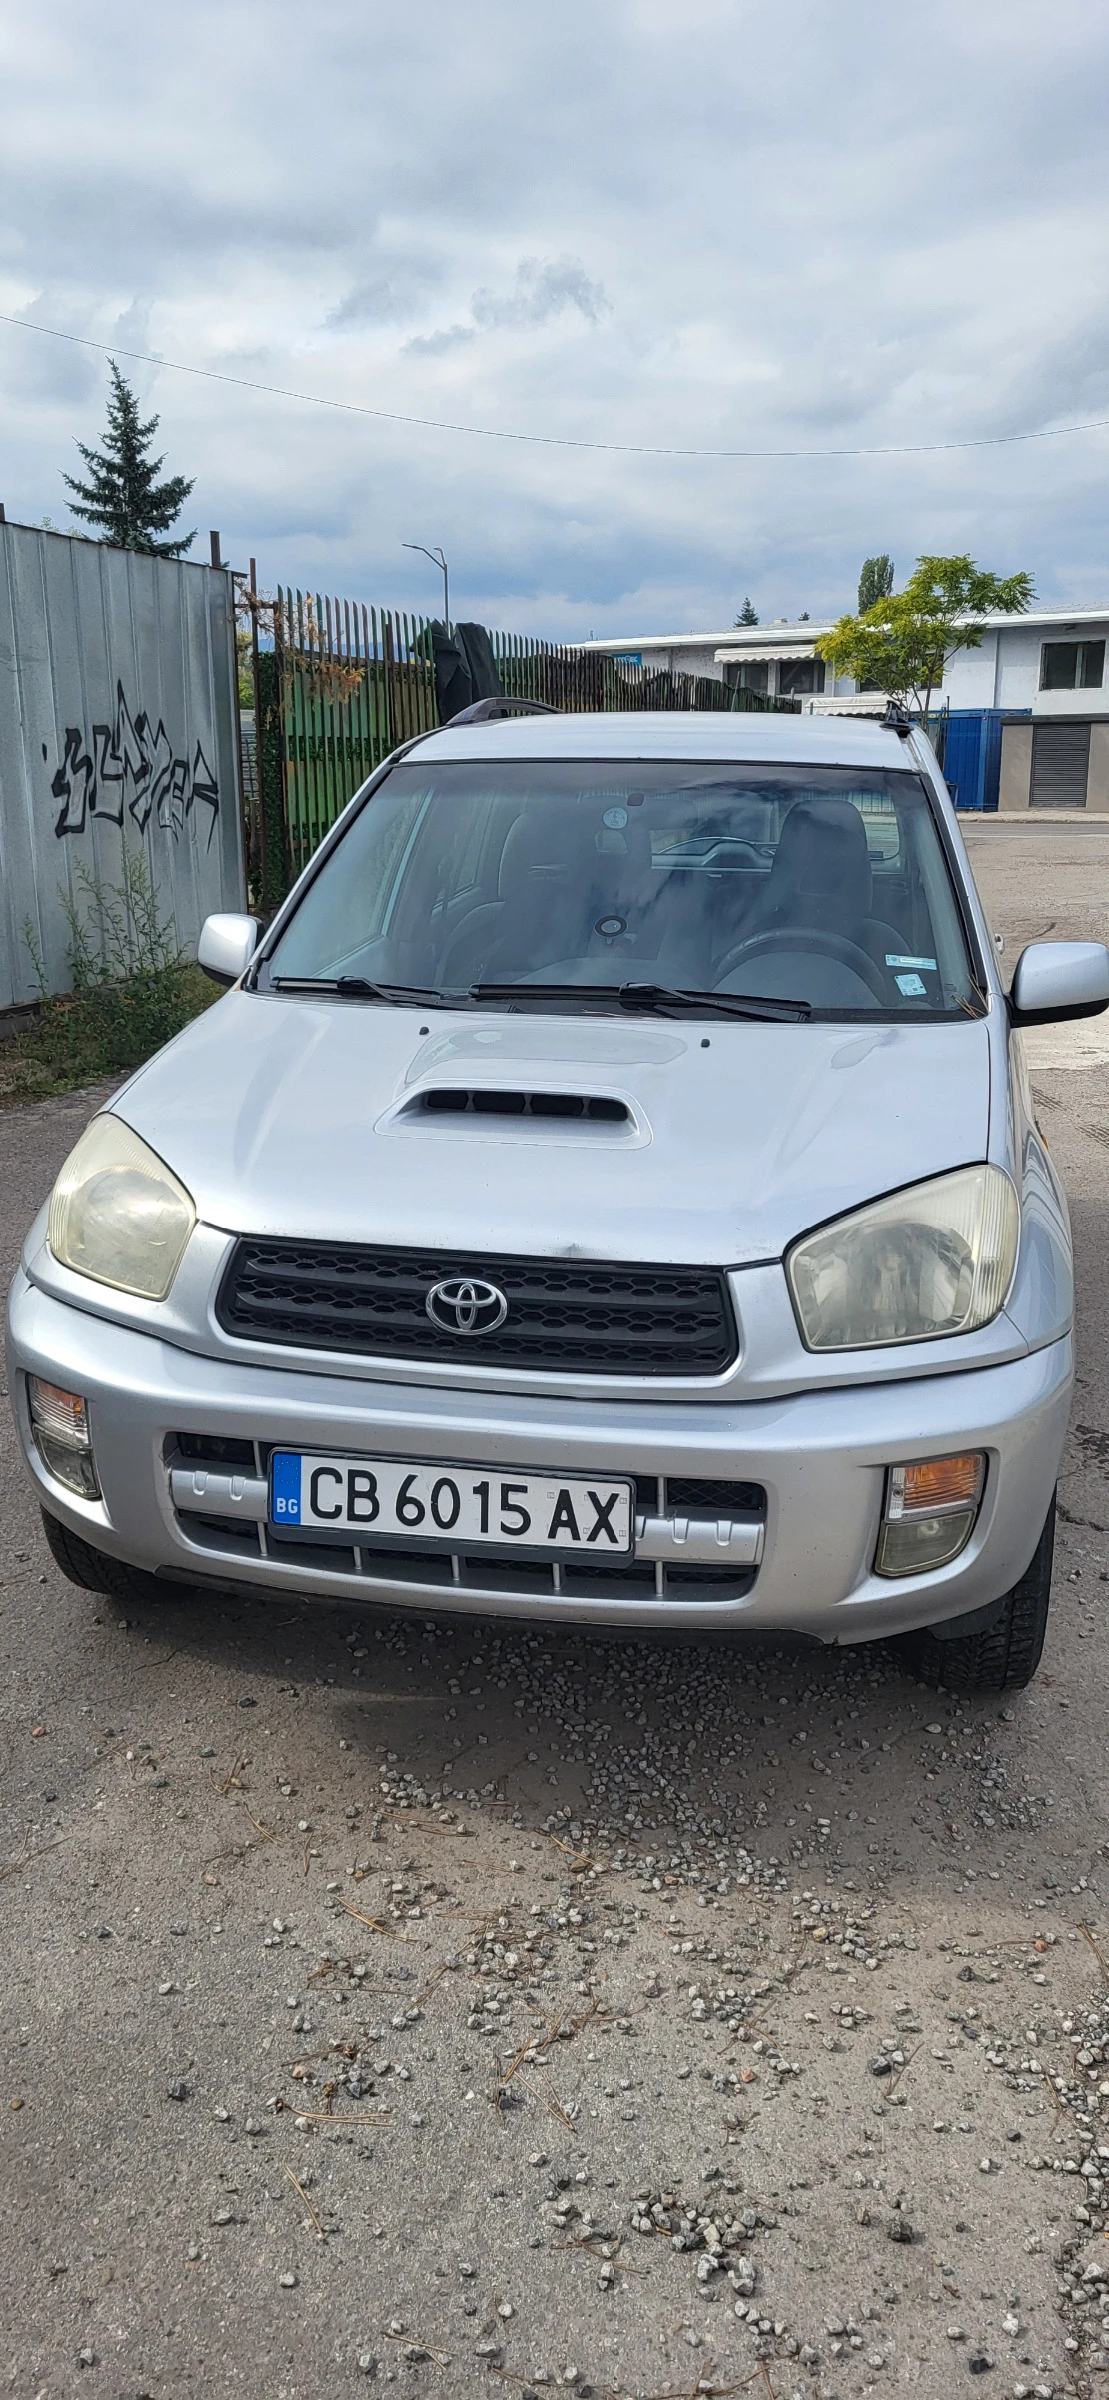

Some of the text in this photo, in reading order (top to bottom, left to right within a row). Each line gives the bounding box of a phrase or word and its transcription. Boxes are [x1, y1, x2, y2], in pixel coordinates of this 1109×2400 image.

[276, 1497, 298, 1514] BG
[310, 1466, 620, 1544] CB 6015 AX
